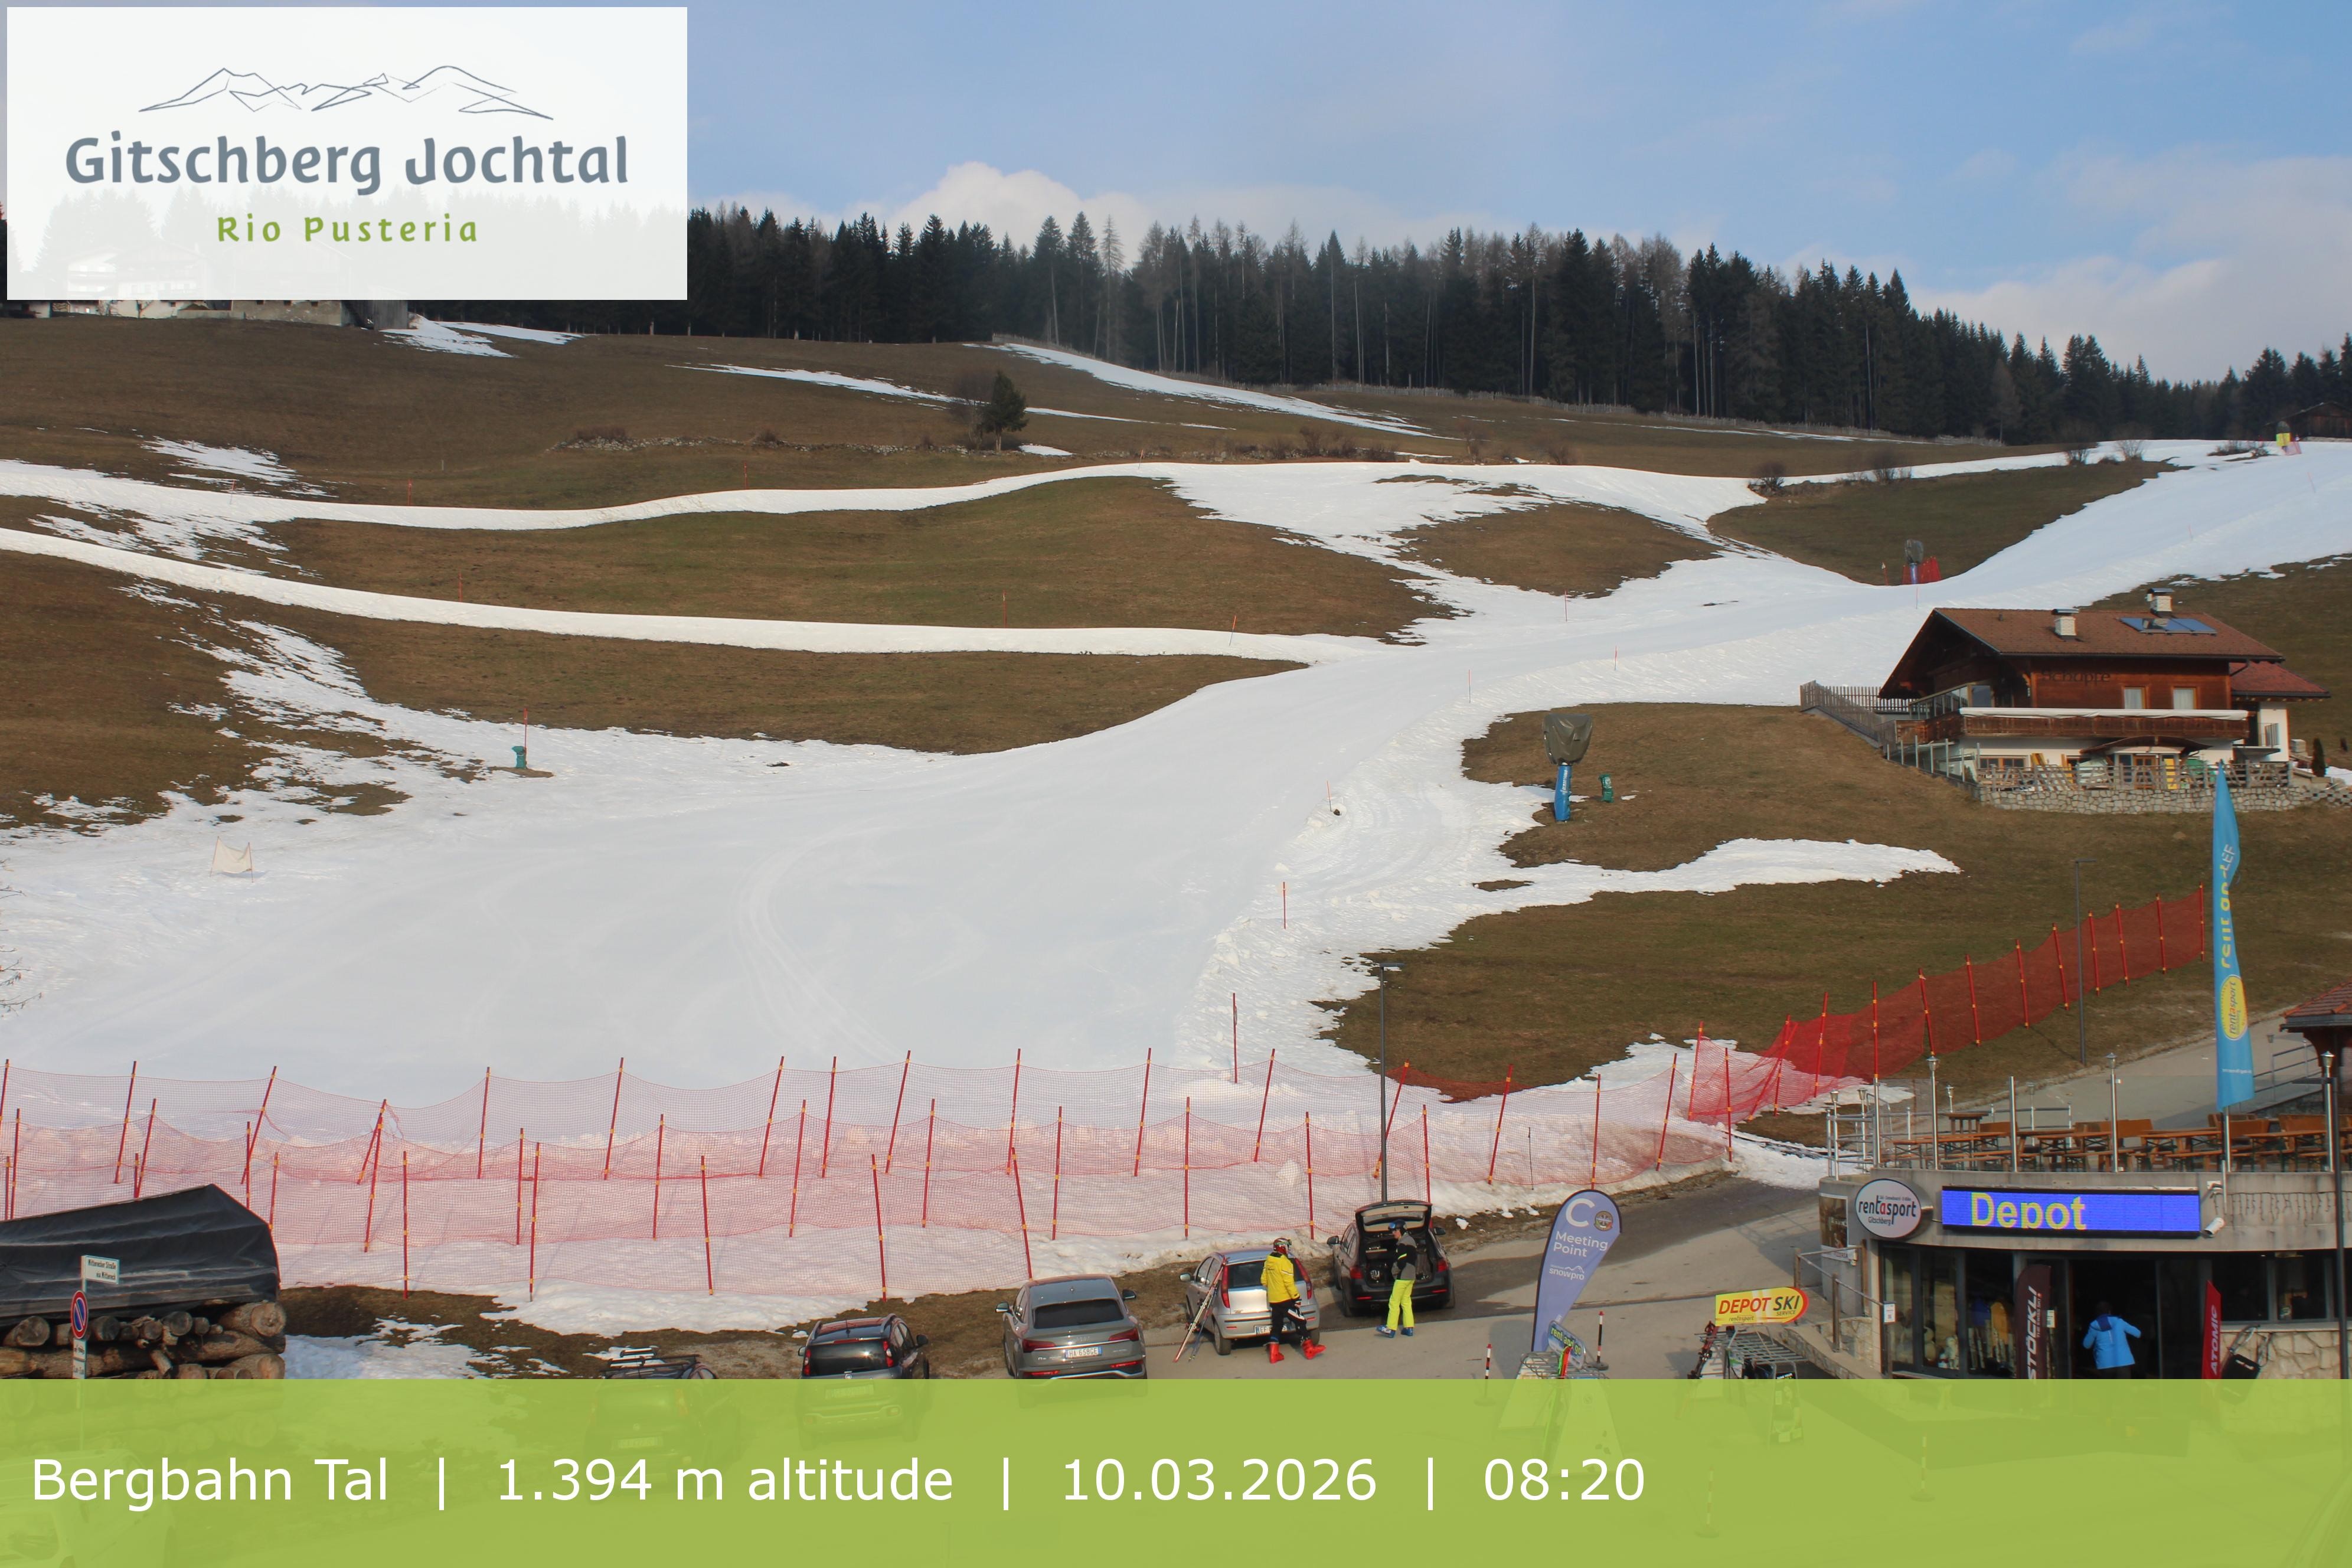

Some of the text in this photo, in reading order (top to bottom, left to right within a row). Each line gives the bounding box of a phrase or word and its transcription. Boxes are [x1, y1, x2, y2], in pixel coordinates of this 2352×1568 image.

[1566, 1198, 1596, 1227] C
[1858, 1194, 1917, 1225] rentasport
[1868, 1216, 1891, 1226] Gitschberg
[1971, 1192, 2087, 1230] Depot
[1553, 1242, 1587, 1257] Point
[1555, 1231, 1609, 1251] Meeting
[1549, 1268, 1585, 1280] snowpro
[1719, 1295, 1801, 1314] DEPOT SKI
[1551, 1327, 1582, 1355] rent and go
[2026, 1285, 2037, 1379] STÖCKLI
[2210, 1304, 2219, 1376] ATOMIC
